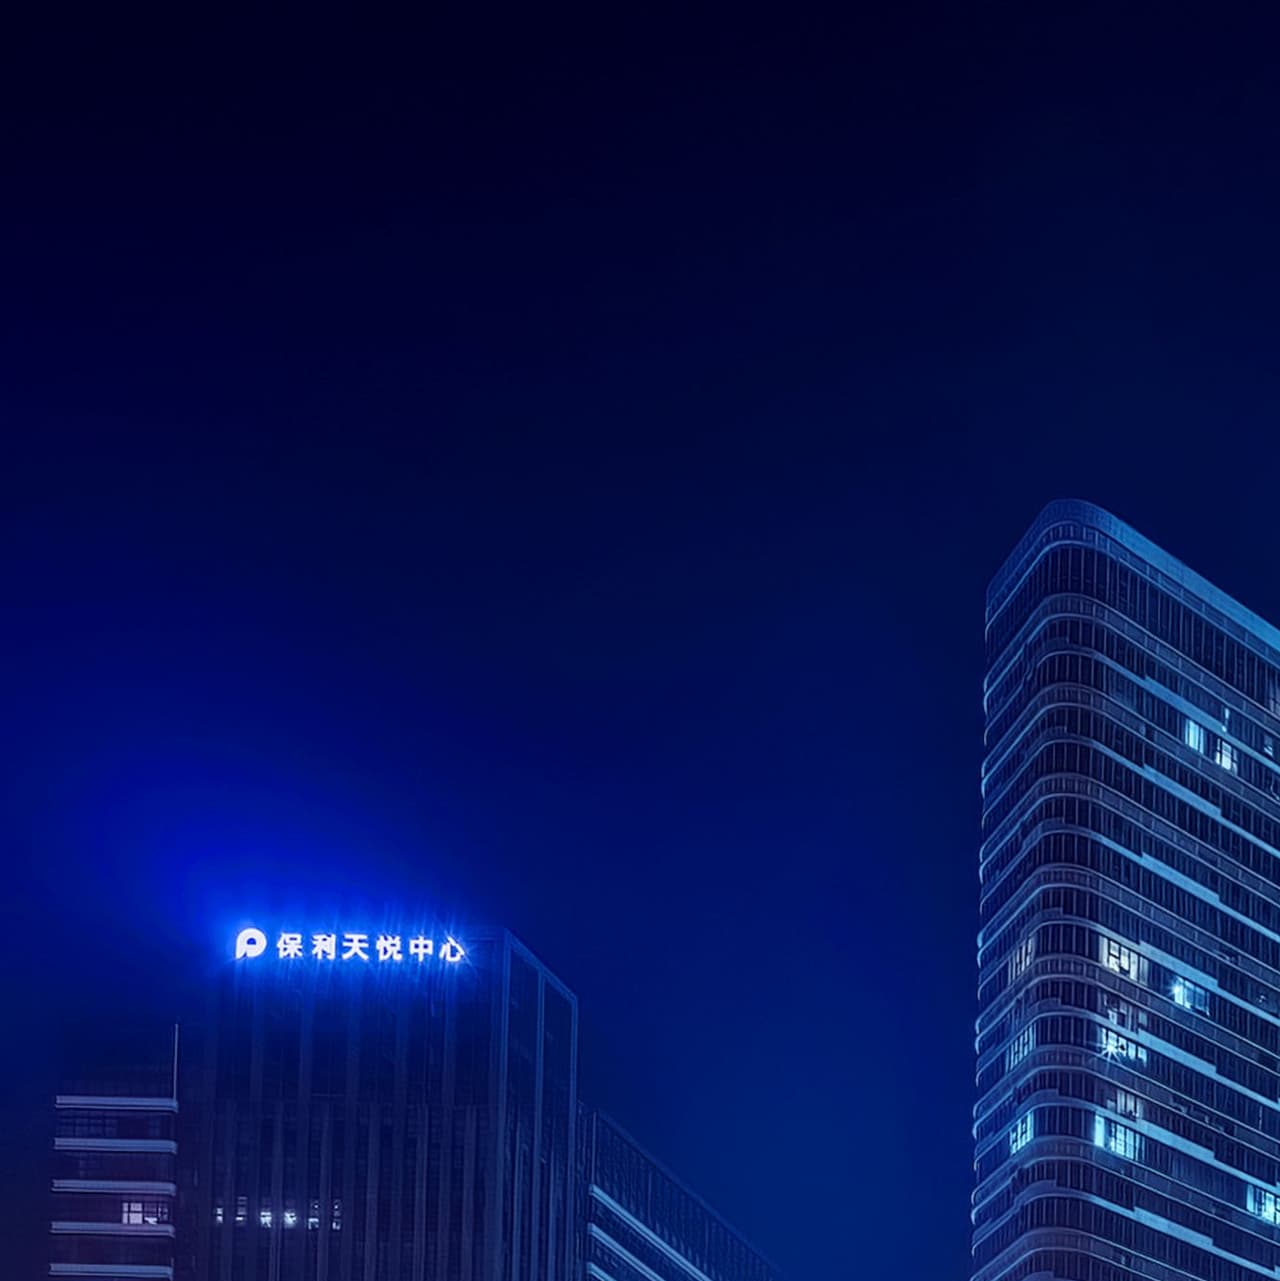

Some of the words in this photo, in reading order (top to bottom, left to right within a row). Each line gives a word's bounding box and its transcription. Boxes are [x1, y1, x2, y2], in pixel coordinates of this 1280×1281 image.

[276, 932, 465, 962] 保利天悦中心
